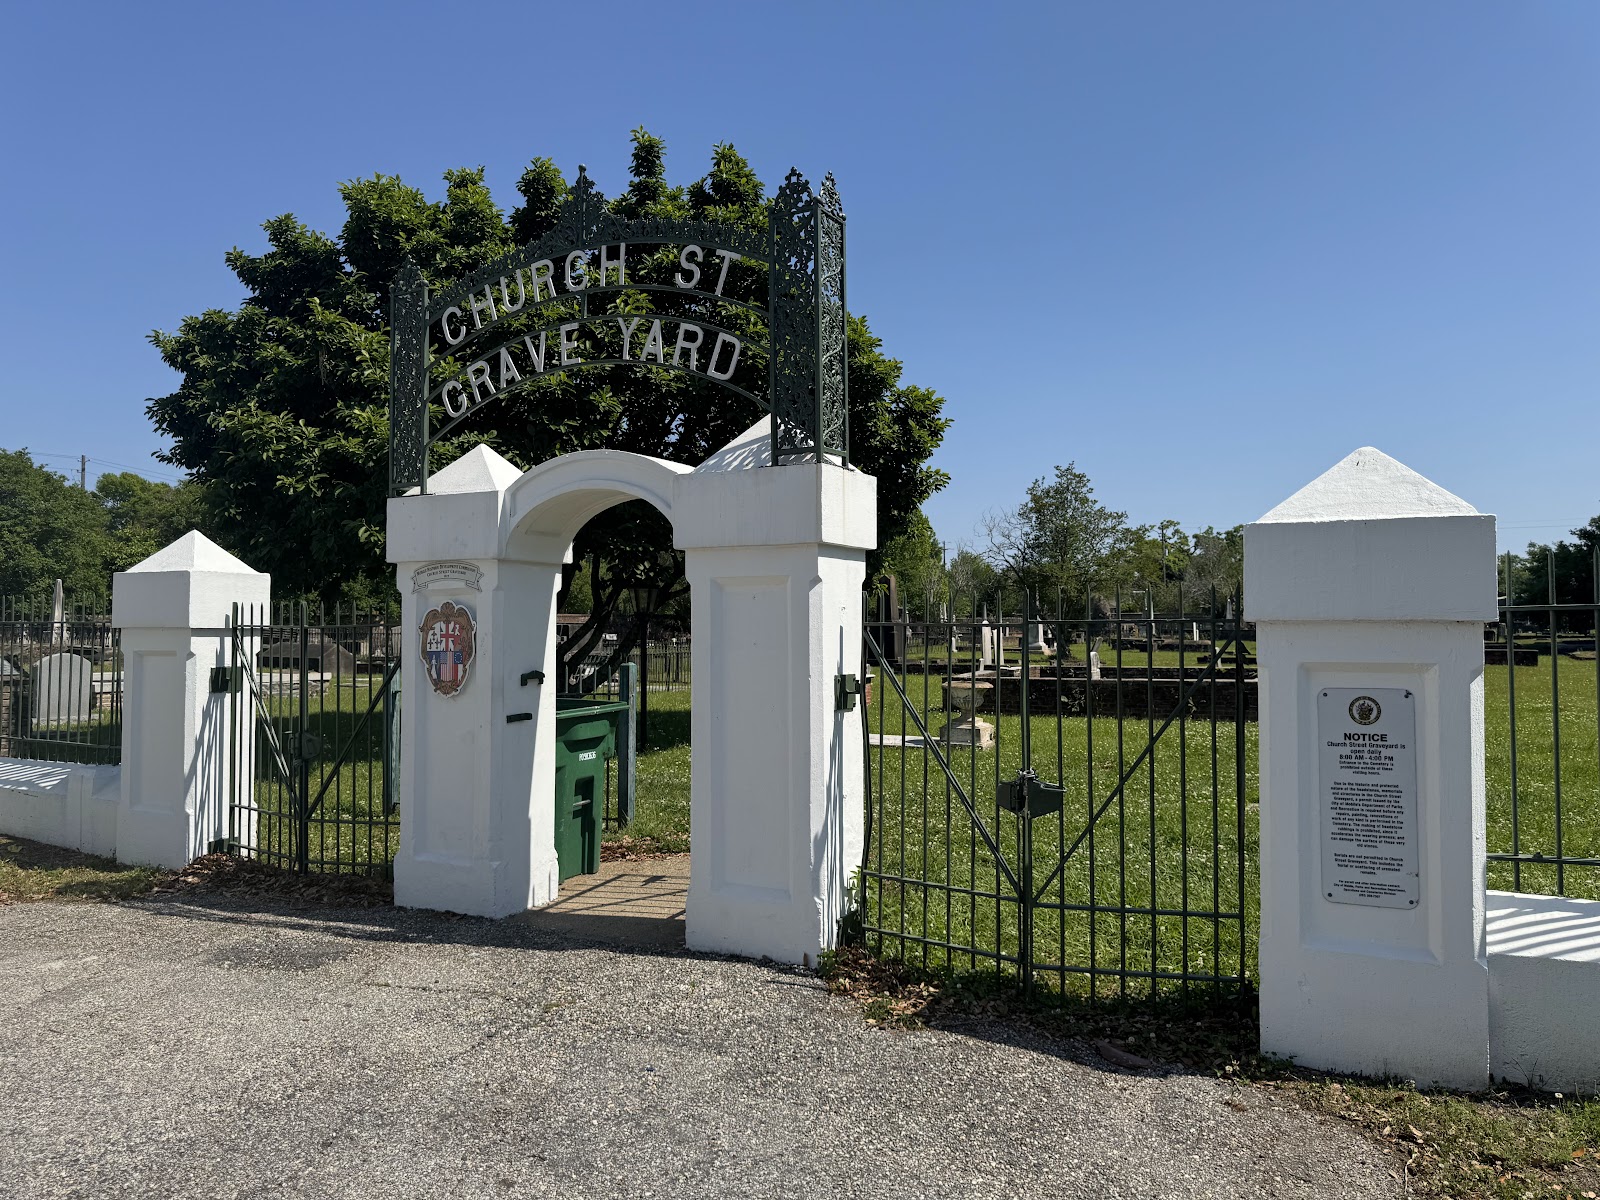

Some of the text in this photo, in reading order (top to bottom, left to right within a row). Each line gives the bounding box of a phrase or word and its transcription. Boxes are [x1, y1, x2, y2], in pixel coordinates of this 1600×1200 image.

[441, 242, 741, 345] CHURCH ST
[441, 317, 741, 418] GRAVE YARD
[1344, 733, 1387, 742] NOTICE
